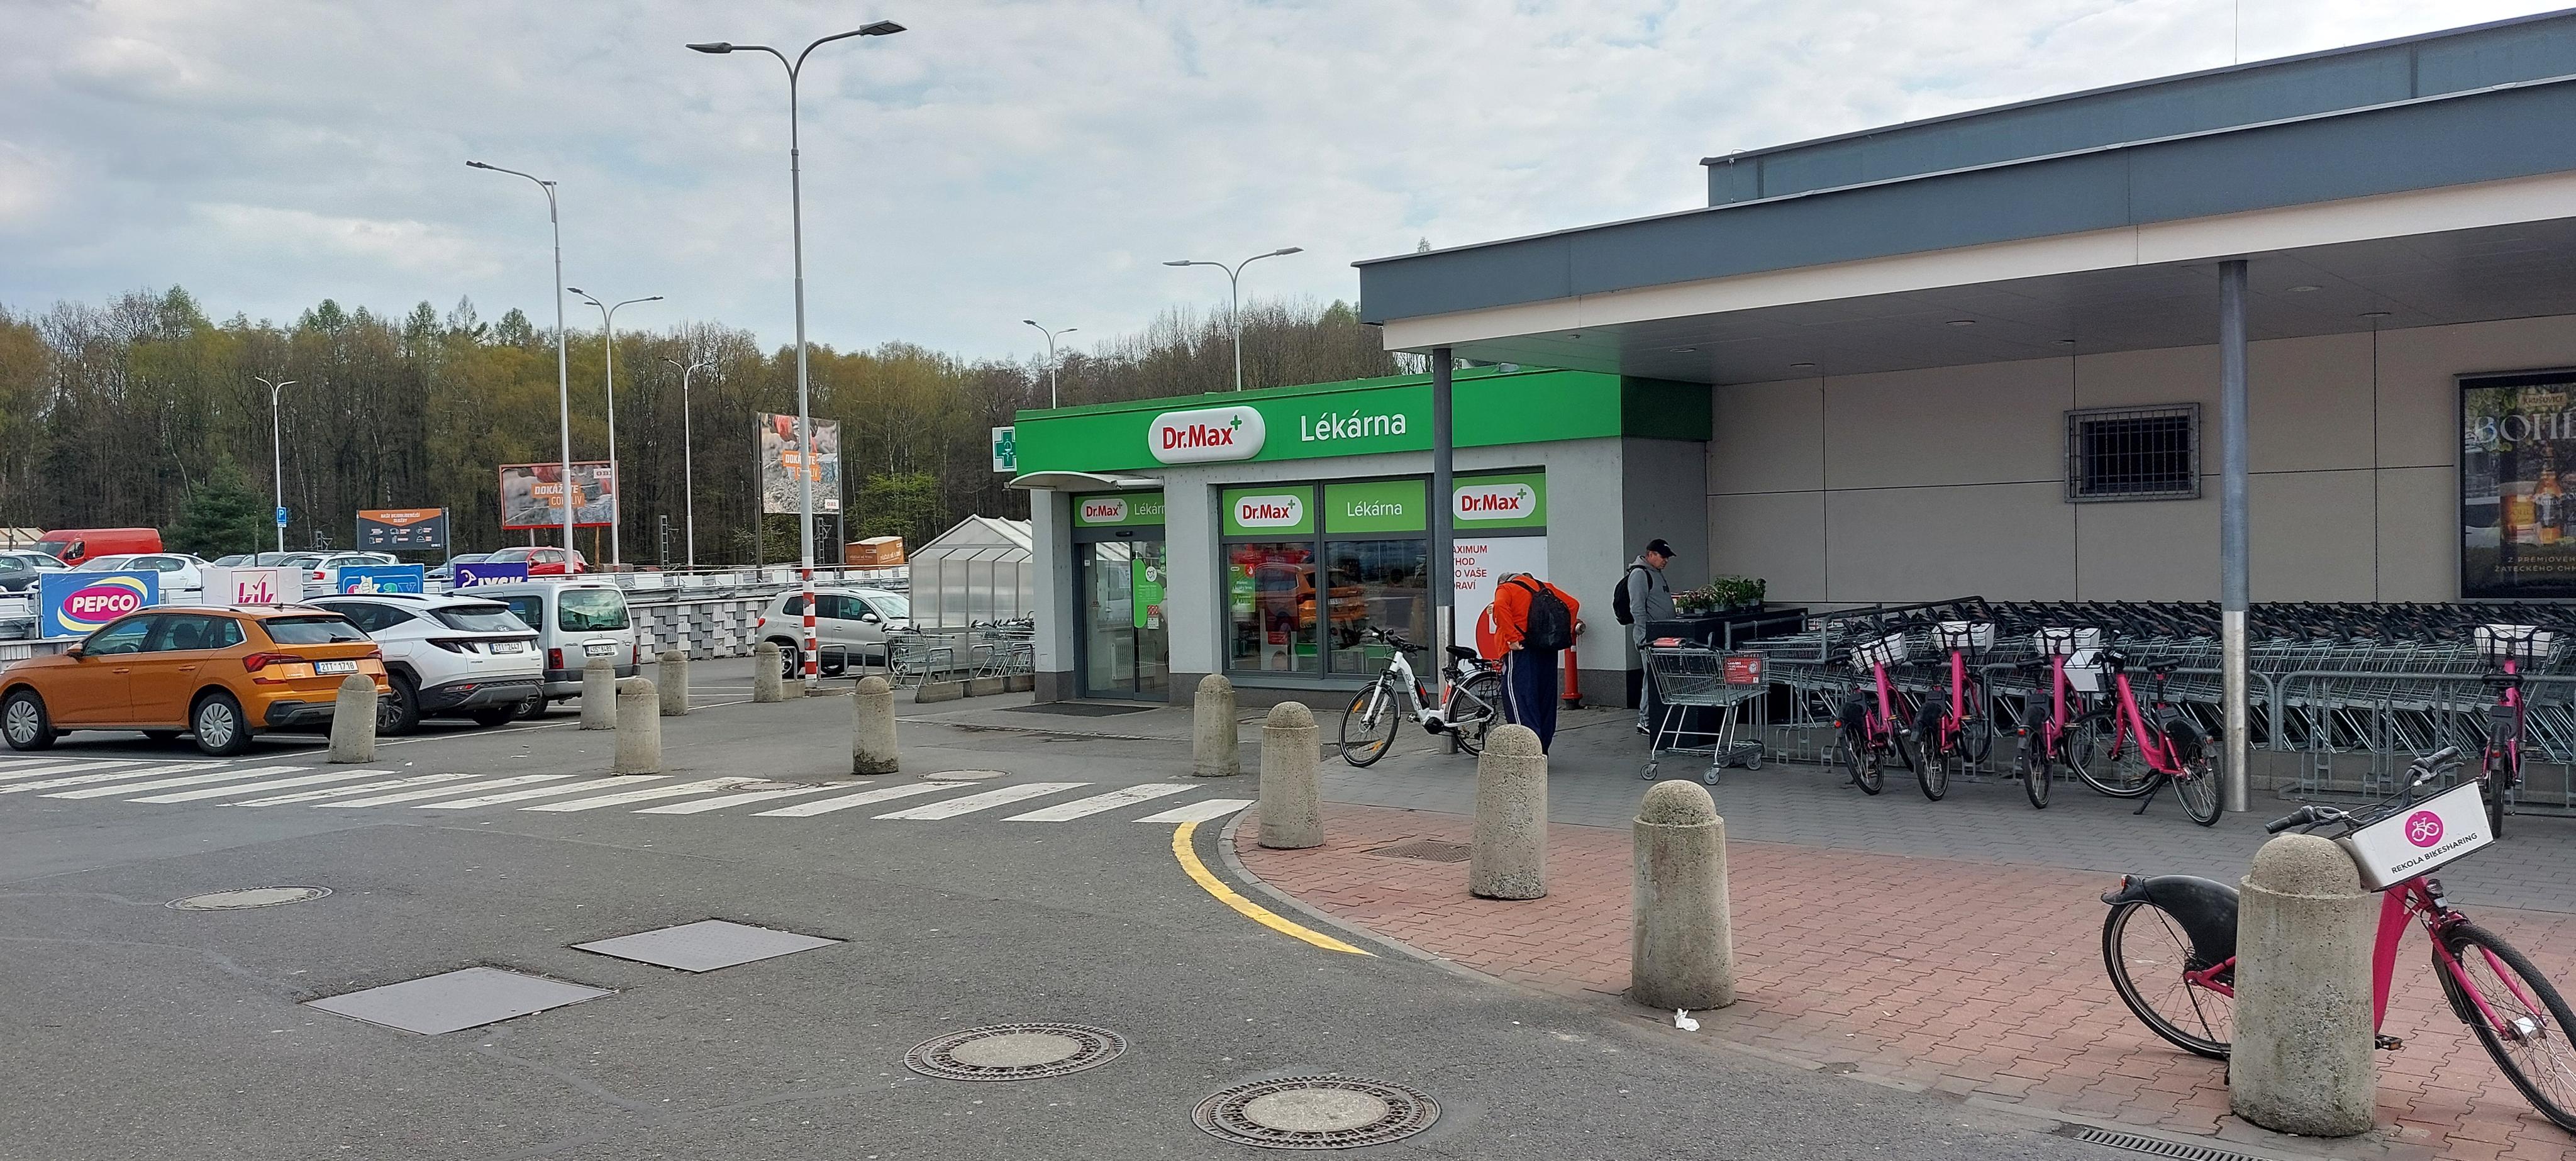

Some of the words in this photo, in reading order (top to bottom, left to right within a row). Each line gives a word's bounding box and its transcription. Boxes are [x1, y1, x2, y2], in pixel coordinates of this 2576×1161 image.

[1301, 409, 1406, 442] Lékárna
[1347, 500, 1402, 516] Lékárna
[1453, 545, 1487, 553] AXIMUM
[1454, 557, 1475, 565] HOD
[1464, 567, 1487, 577] VAŠE
[1455, 579, 1476, 590] RAVÍ
[72, 594, 135, 613] PEPCO
[321, 662, 334, 671] 2TT
[2390, 856, 2424, 874] REKOLA
[2424, 832, 2478, 860] BIKESHARING
